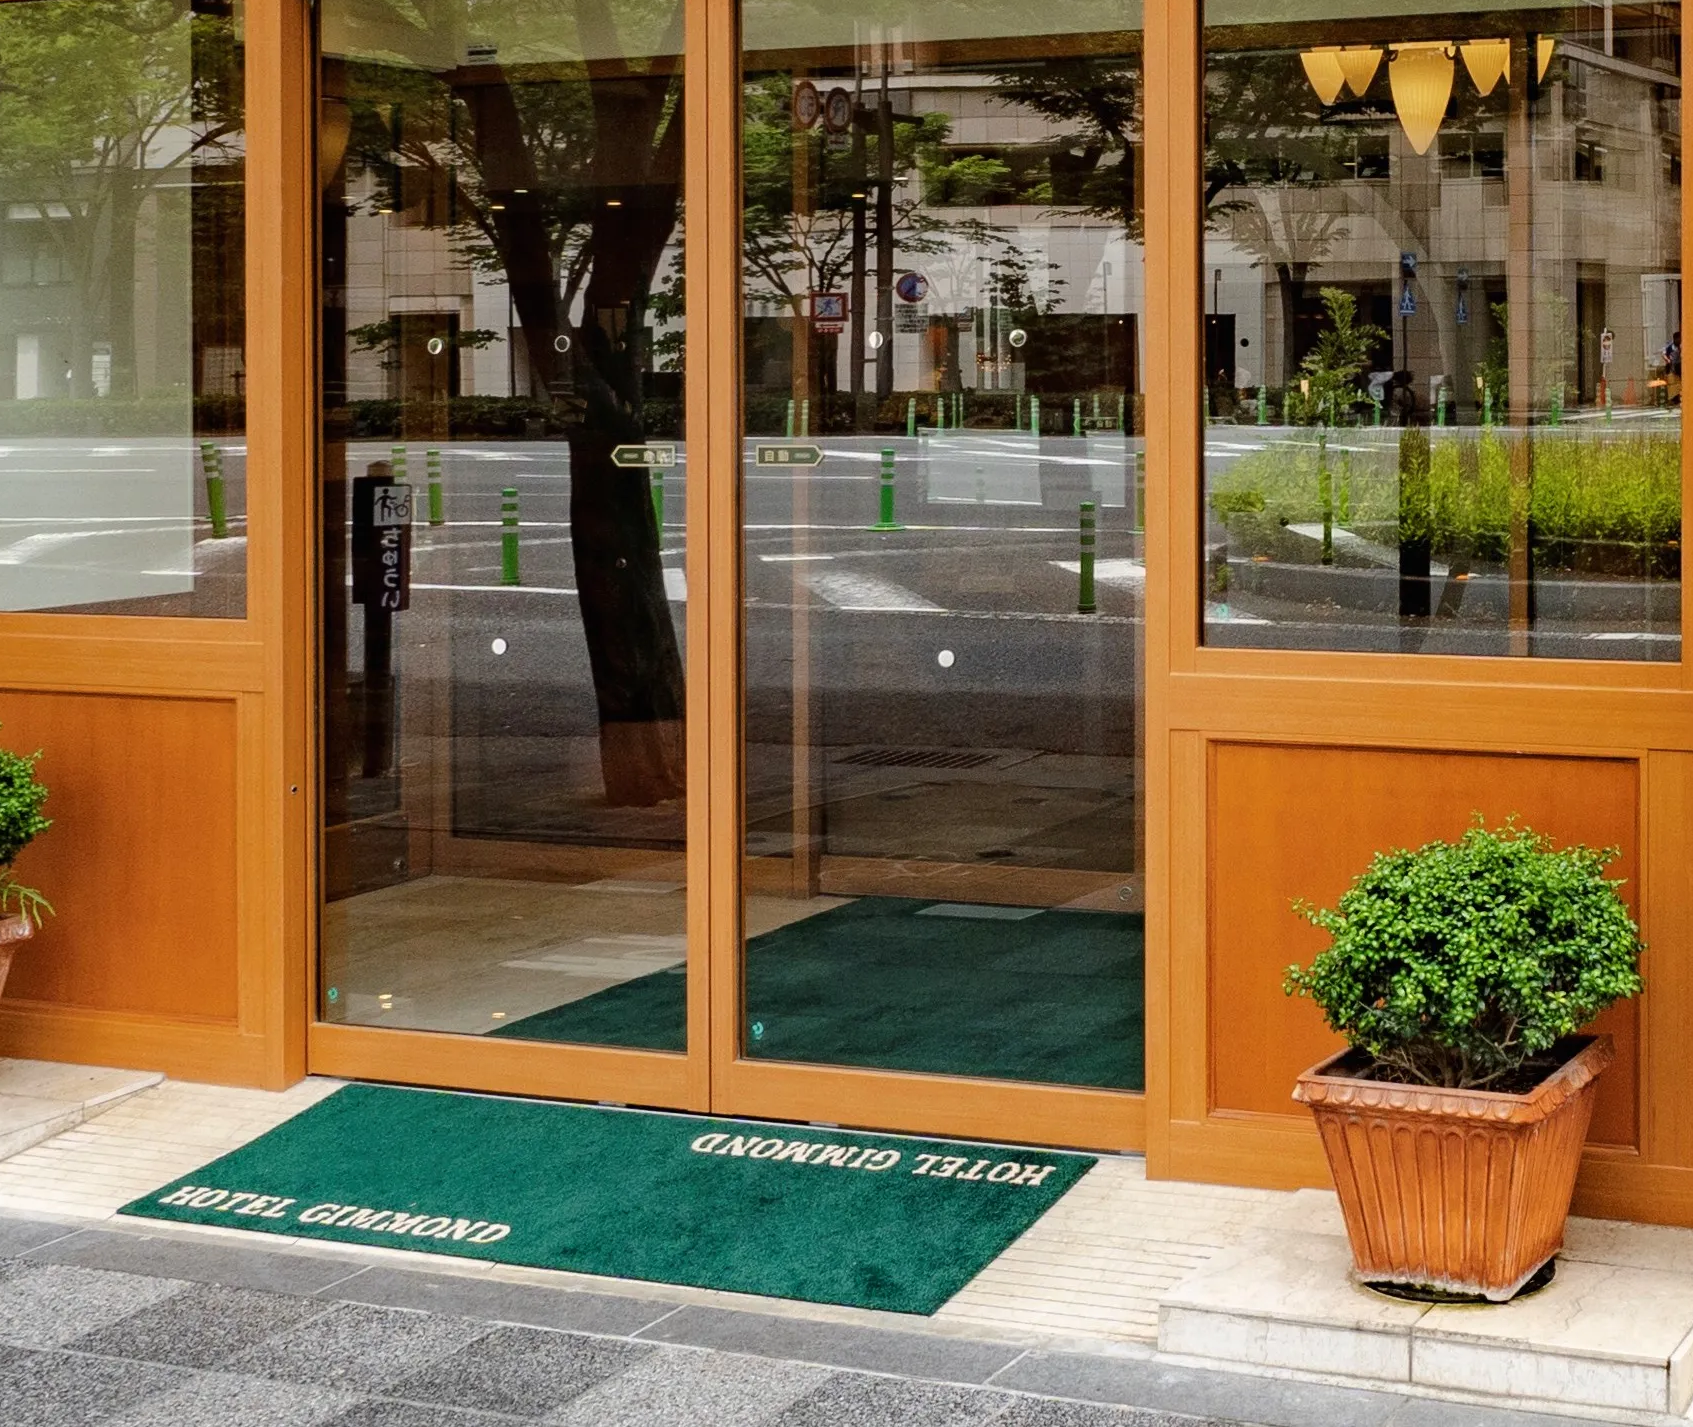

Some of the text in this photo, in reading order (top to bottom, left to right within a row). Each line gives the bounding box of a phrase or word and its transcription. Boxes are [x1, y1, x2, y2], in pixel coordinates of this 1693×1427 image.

[691, 1132, 1057, 1186] HOTEL GIMMOND
[159, 1185, 511, 1244] HOTEL GIMMOND
